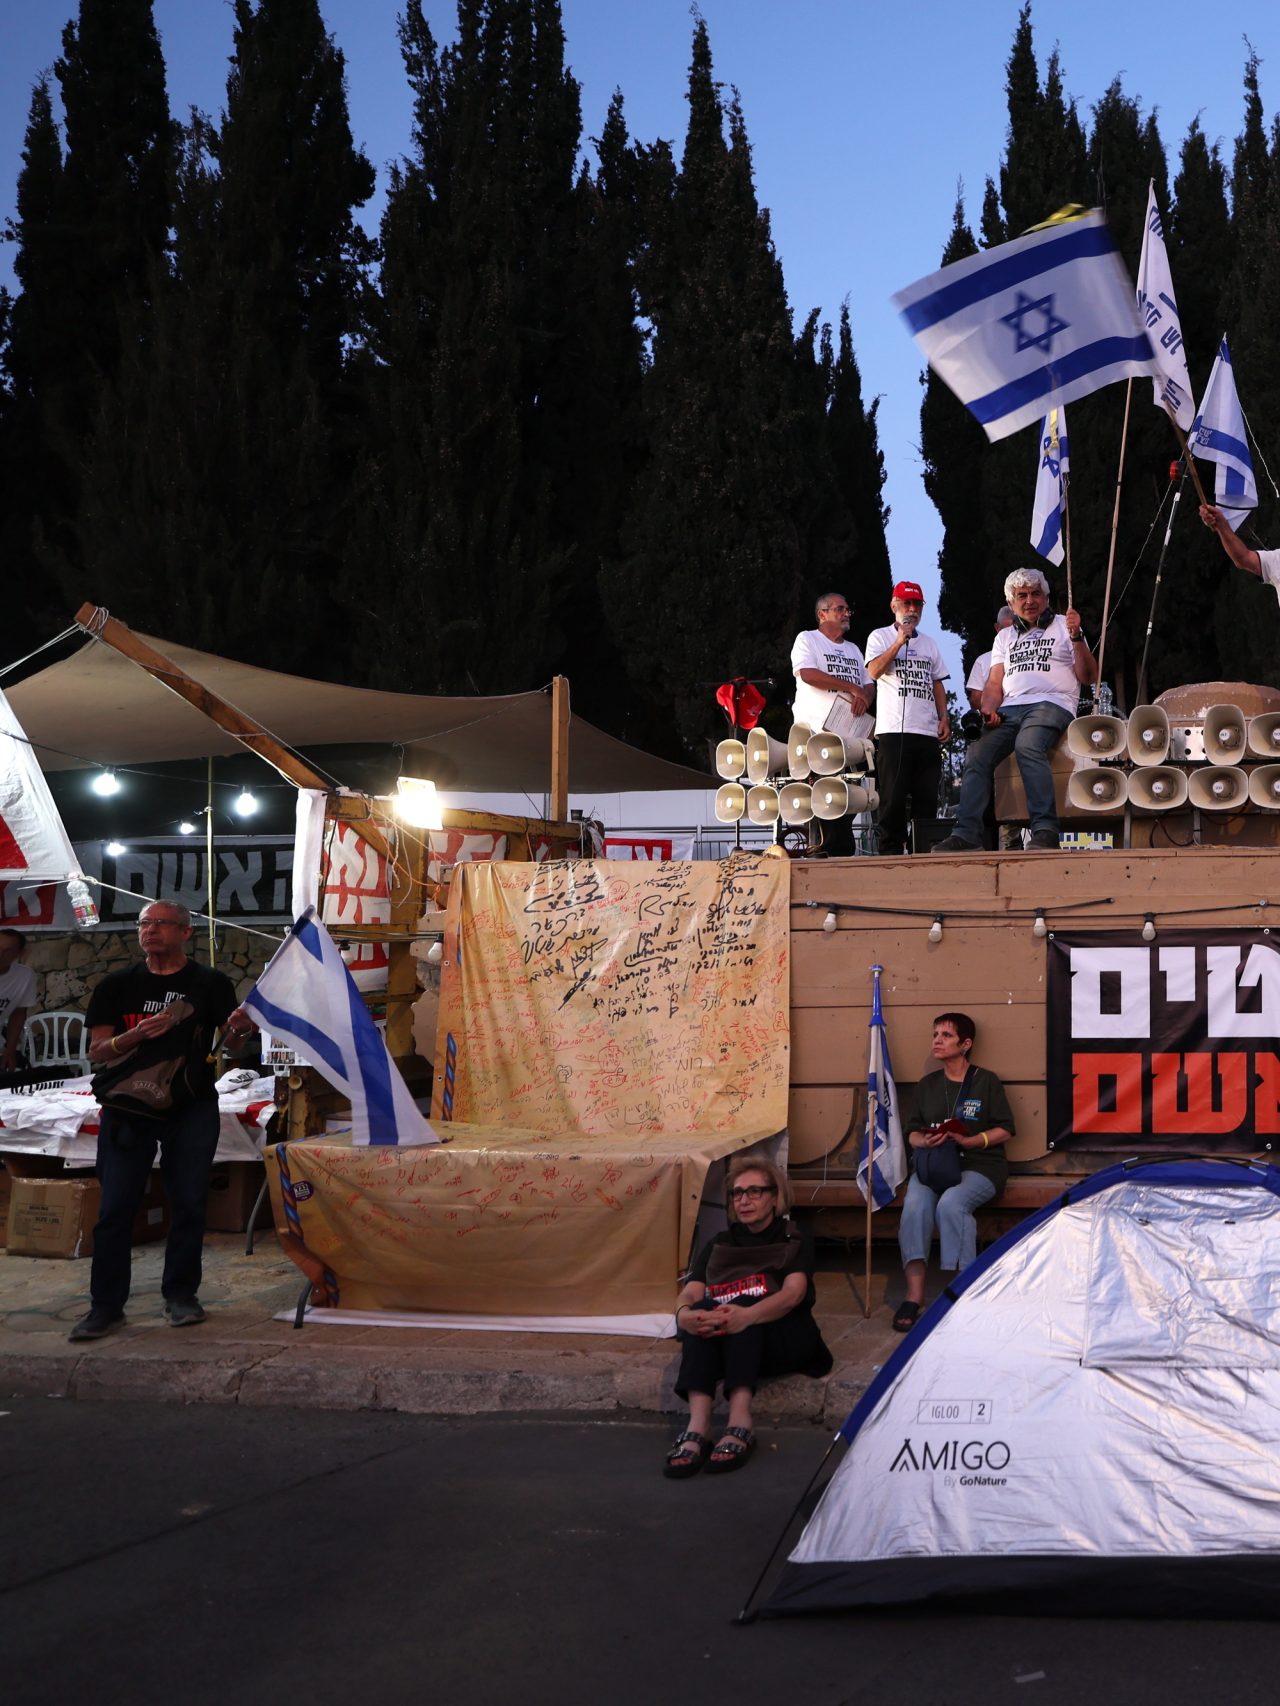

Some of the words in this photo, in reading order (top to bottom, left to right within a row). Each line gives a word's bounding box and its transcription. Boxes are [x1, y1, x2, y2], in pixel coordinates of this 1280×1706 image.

[1033, 638, 1056, 648] לוחמי
[823, 654, 842, 663] כיפור
[827, 664, 851, 674] נאבקים
[1007, 663, 1035, 677] המדינה
[1036, 662, 1051, 672] של
[931, 1405, 960, 1419] IGLOO
[977, 1403, 986, 1416] 2
[889, 1438, 1011, 1472] AMIGO
[959, 1476, 1007, 1486] GoNature
